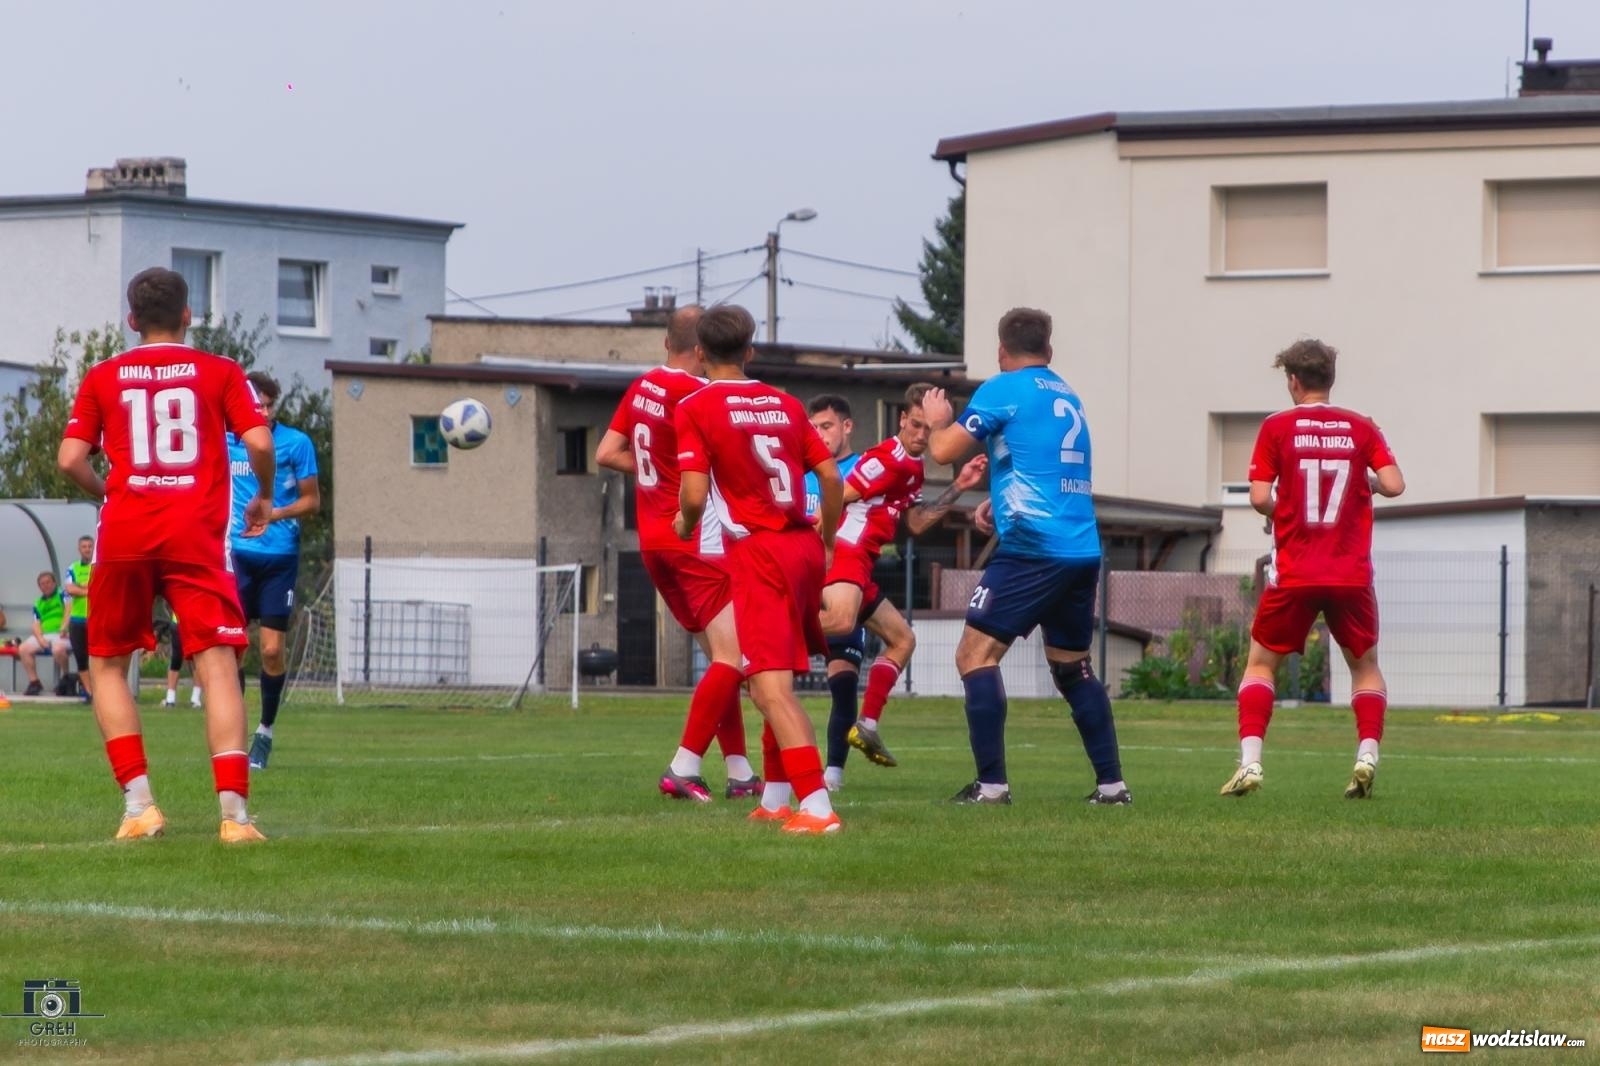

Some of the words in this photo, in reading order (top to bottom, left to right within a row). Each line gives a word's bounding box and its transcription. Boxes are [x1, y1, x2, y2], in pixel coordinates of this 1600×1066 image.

[119, 365, 153, 380] UNIA
[154, 363, 196, 380] TURZA
[121, 387, 198, 465] 18
[729, 410, 757, 424] UNIA
[754, 410, 791, 425] TURZA
[965, 414, 982, 433] C
[1294, 434, 1320, 448] UNIA
[1320, 435, 1355, 449] TURZA
[634, 422, 658, 487] 6
[753, 434, 792, 502] 5
[1299, 458, 1351, 524] 17
[970, 585, 990, 609] 21
